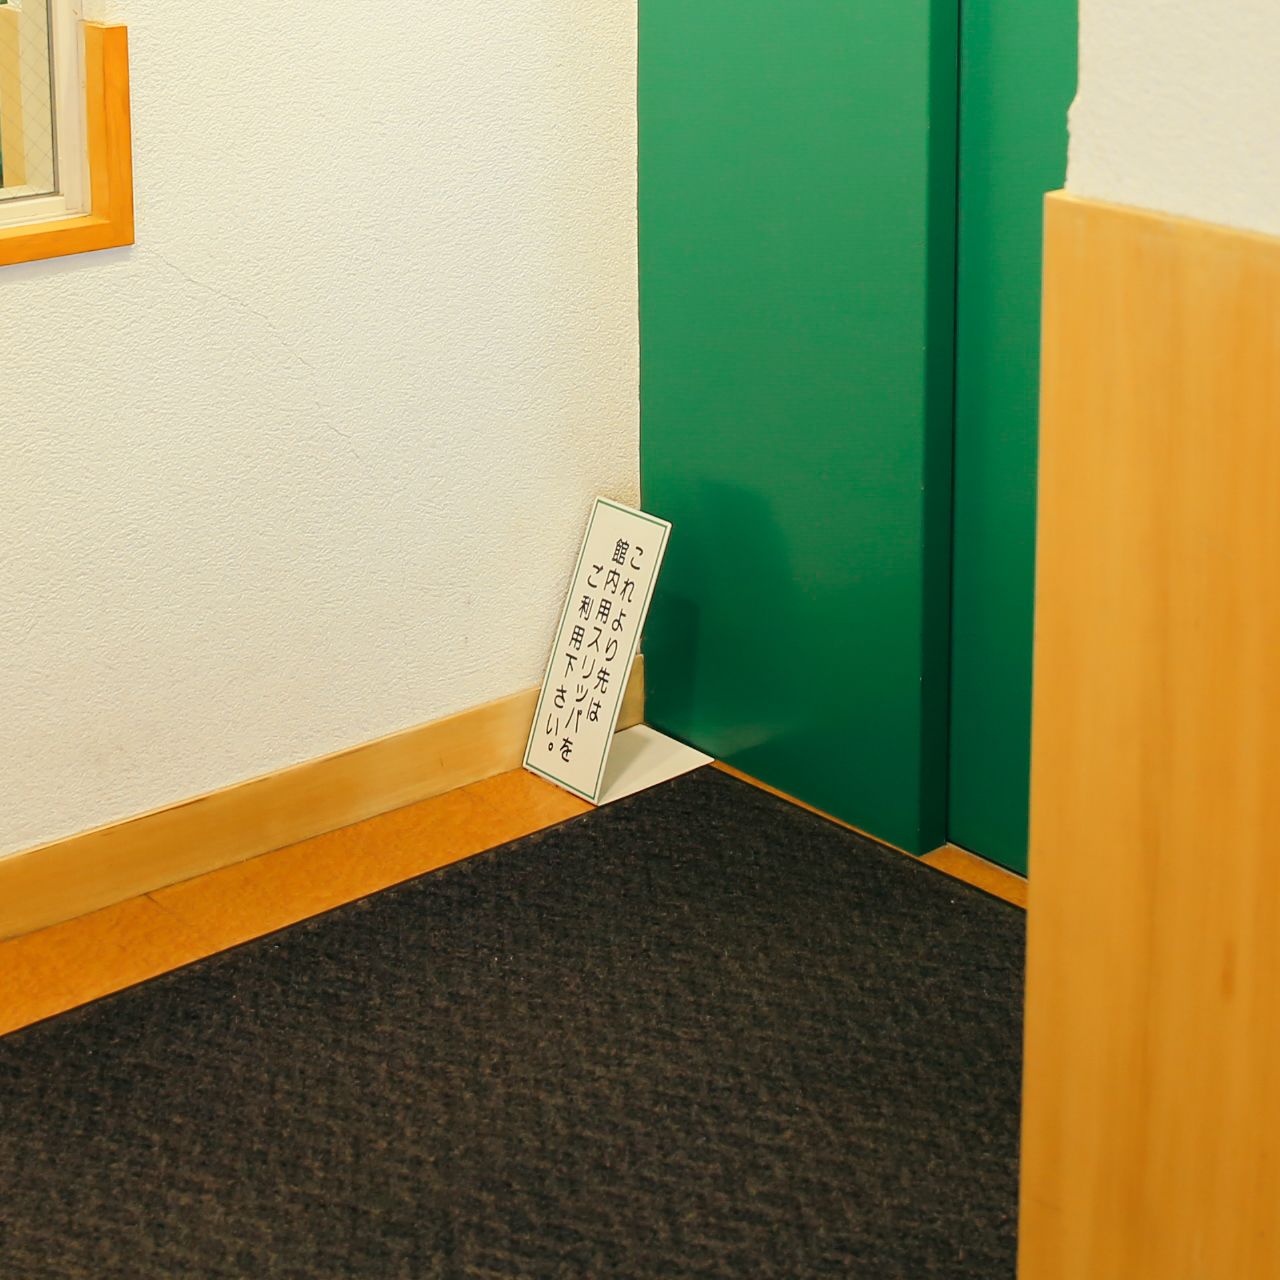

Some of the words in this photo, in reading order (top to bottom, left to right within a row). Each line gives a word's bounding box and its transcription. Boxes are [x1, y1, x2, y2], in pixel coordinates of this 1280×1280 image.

[545, 563, 604, 752] ご利用下さい。
[558, 537, 630, 763] 館内用スリッパを
[586, 545, 644, 723] これより先は
